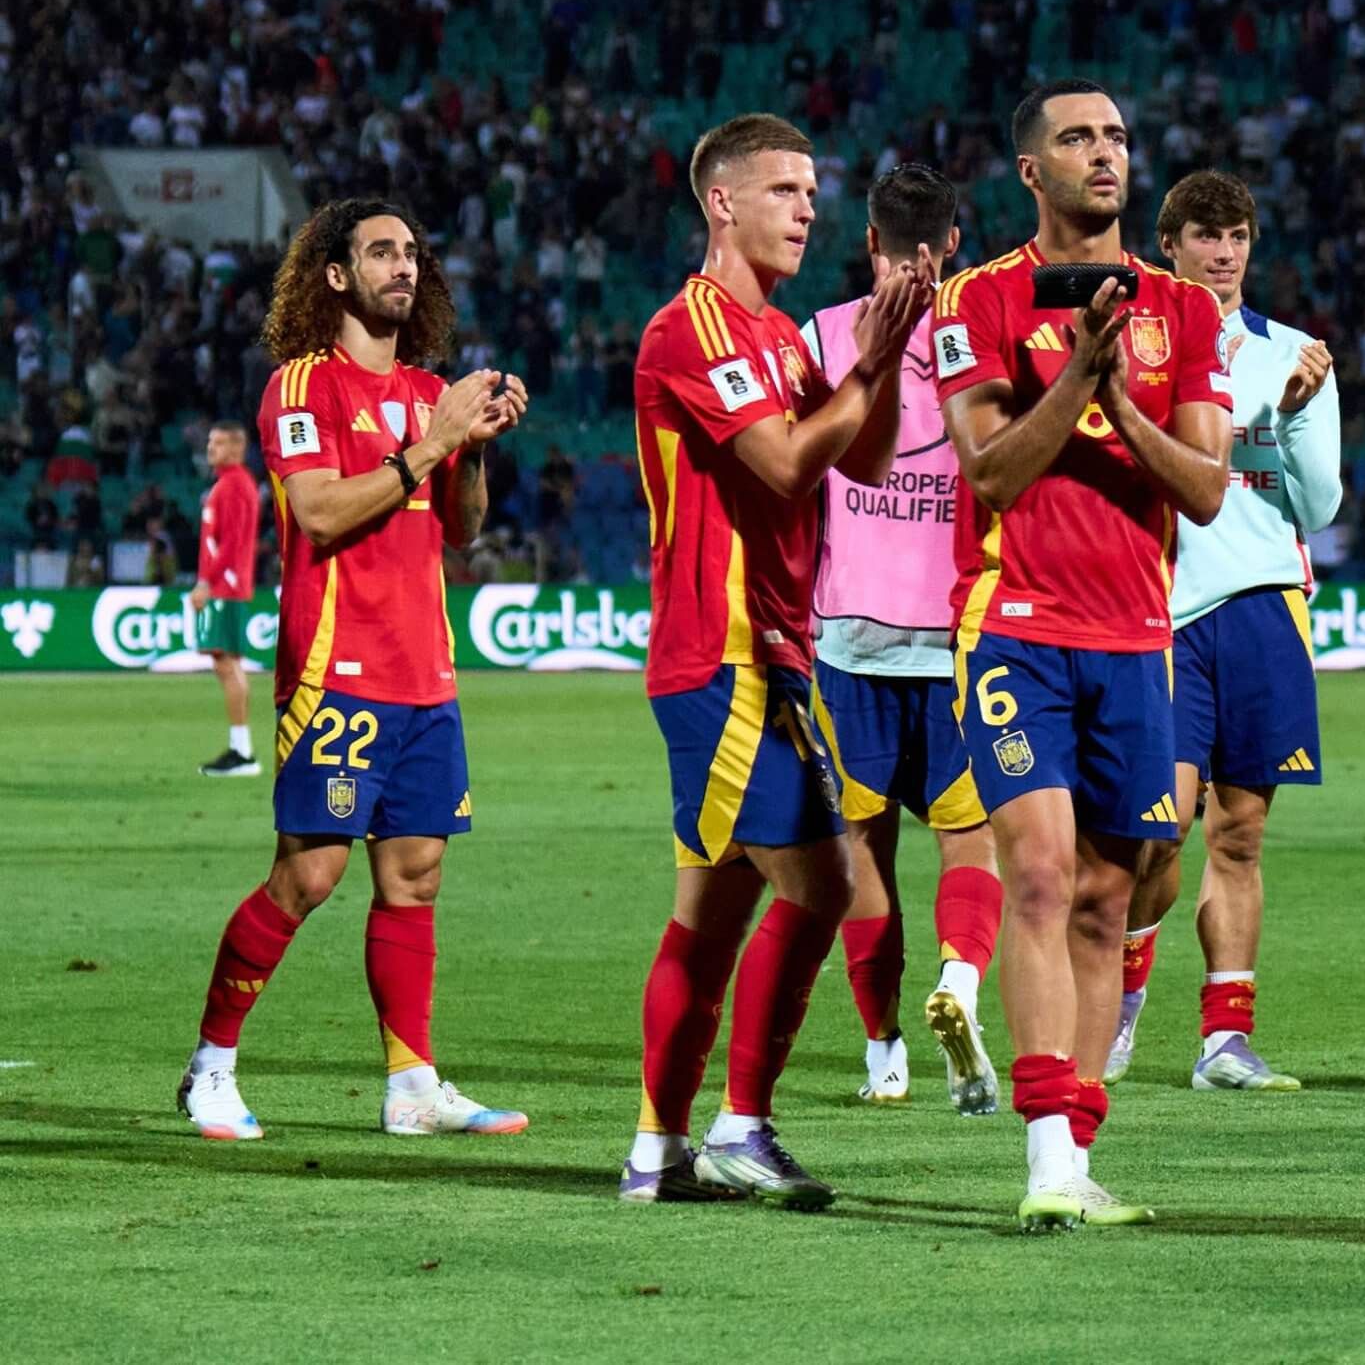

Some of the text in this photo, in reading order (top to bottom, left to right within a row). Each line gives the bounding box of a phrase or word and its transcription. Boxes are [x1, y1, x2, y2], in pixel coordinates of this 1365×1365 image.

[846, 487, 956, 523] QUALIFIE
[469, 583, 651, 667] Carlsbe
[976, 666, 1018, 726] 6
[312, 707, 378, 769] 22
